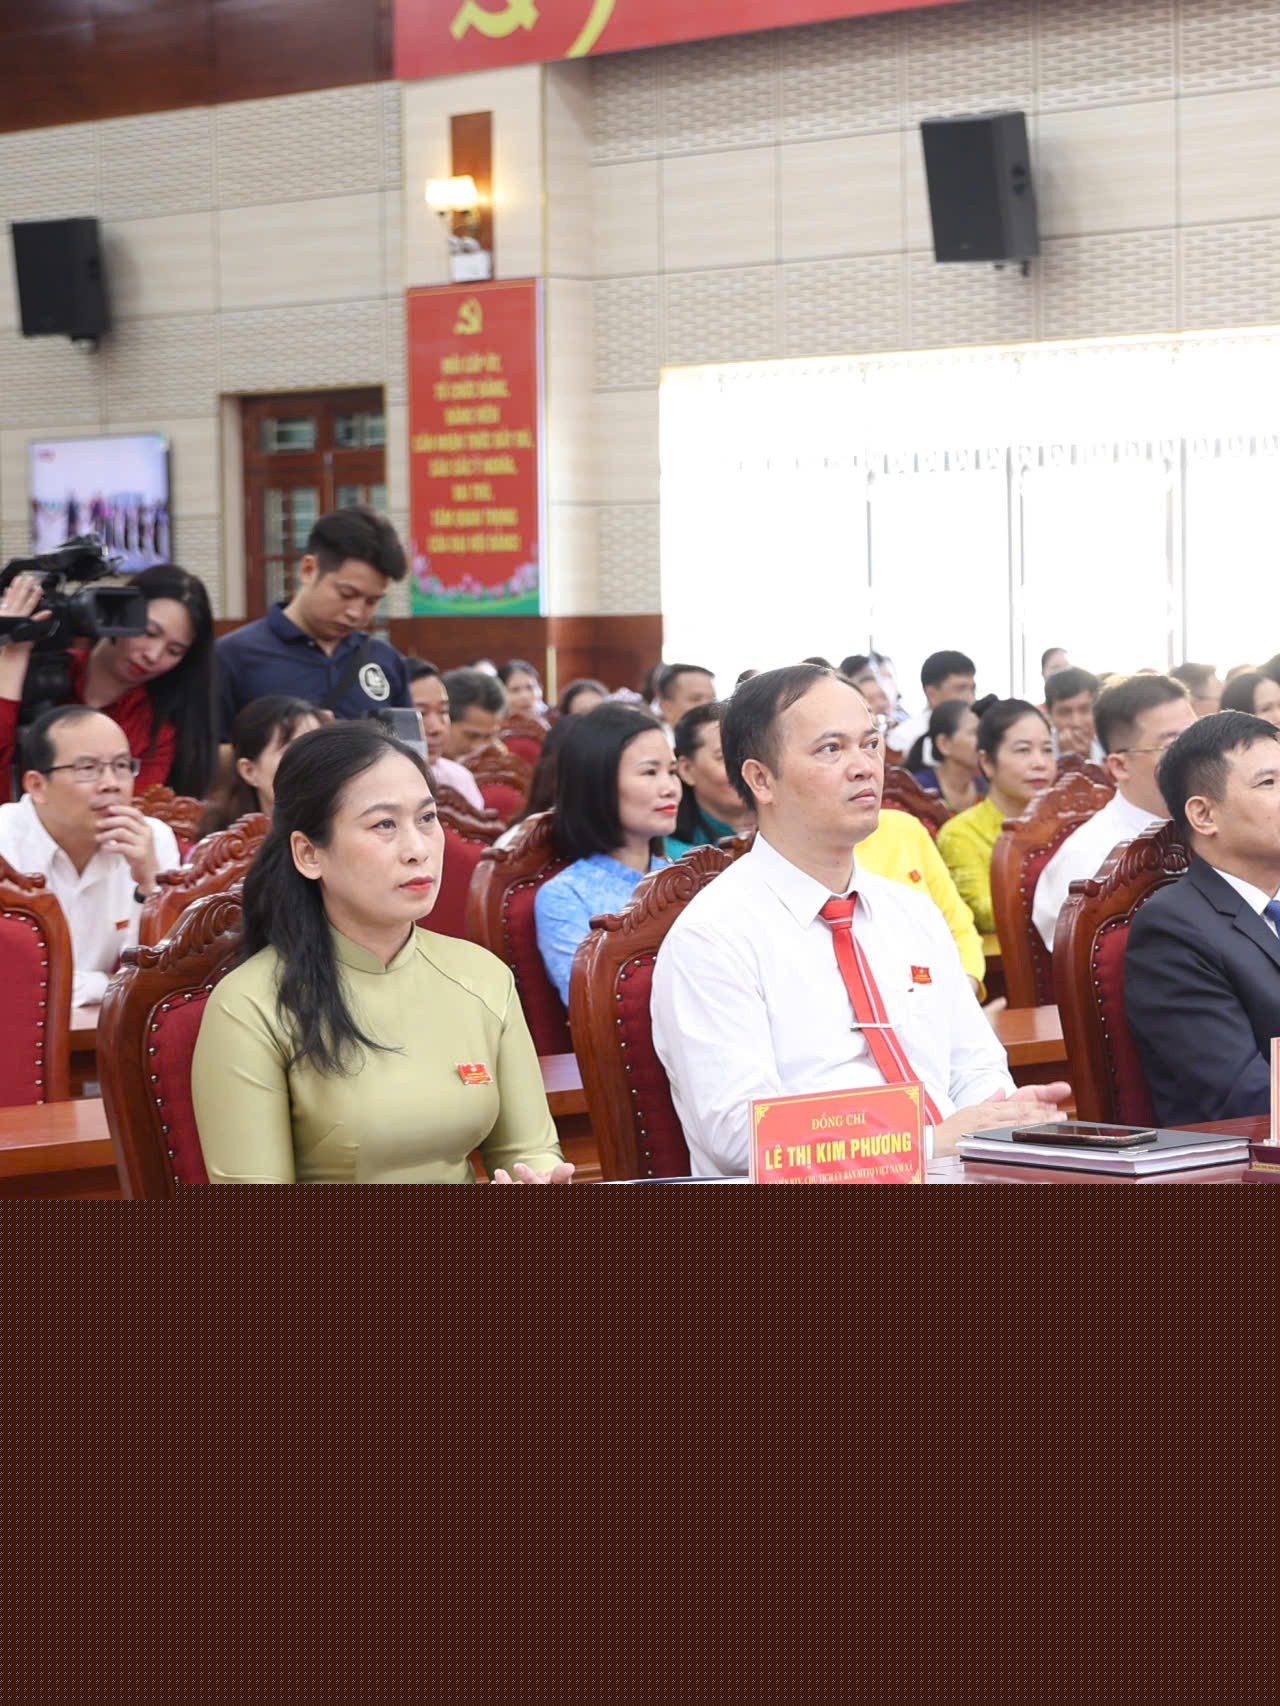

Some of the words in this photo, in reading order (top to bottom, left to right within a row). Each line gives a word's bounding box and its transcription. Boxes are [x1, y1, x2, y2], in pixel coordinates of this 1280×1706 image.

[811, 1111, 844, 1130] ĐỒNG
[846, 1109, 865, 1126] CHÍ
[765, 1144, 783, 1170] LÊ
[787, 1144, 812, 1169] THỊ
[816, 1140, 846, 1163] KIM
[850, 1131, 912, 1159] PHƯƠNG
